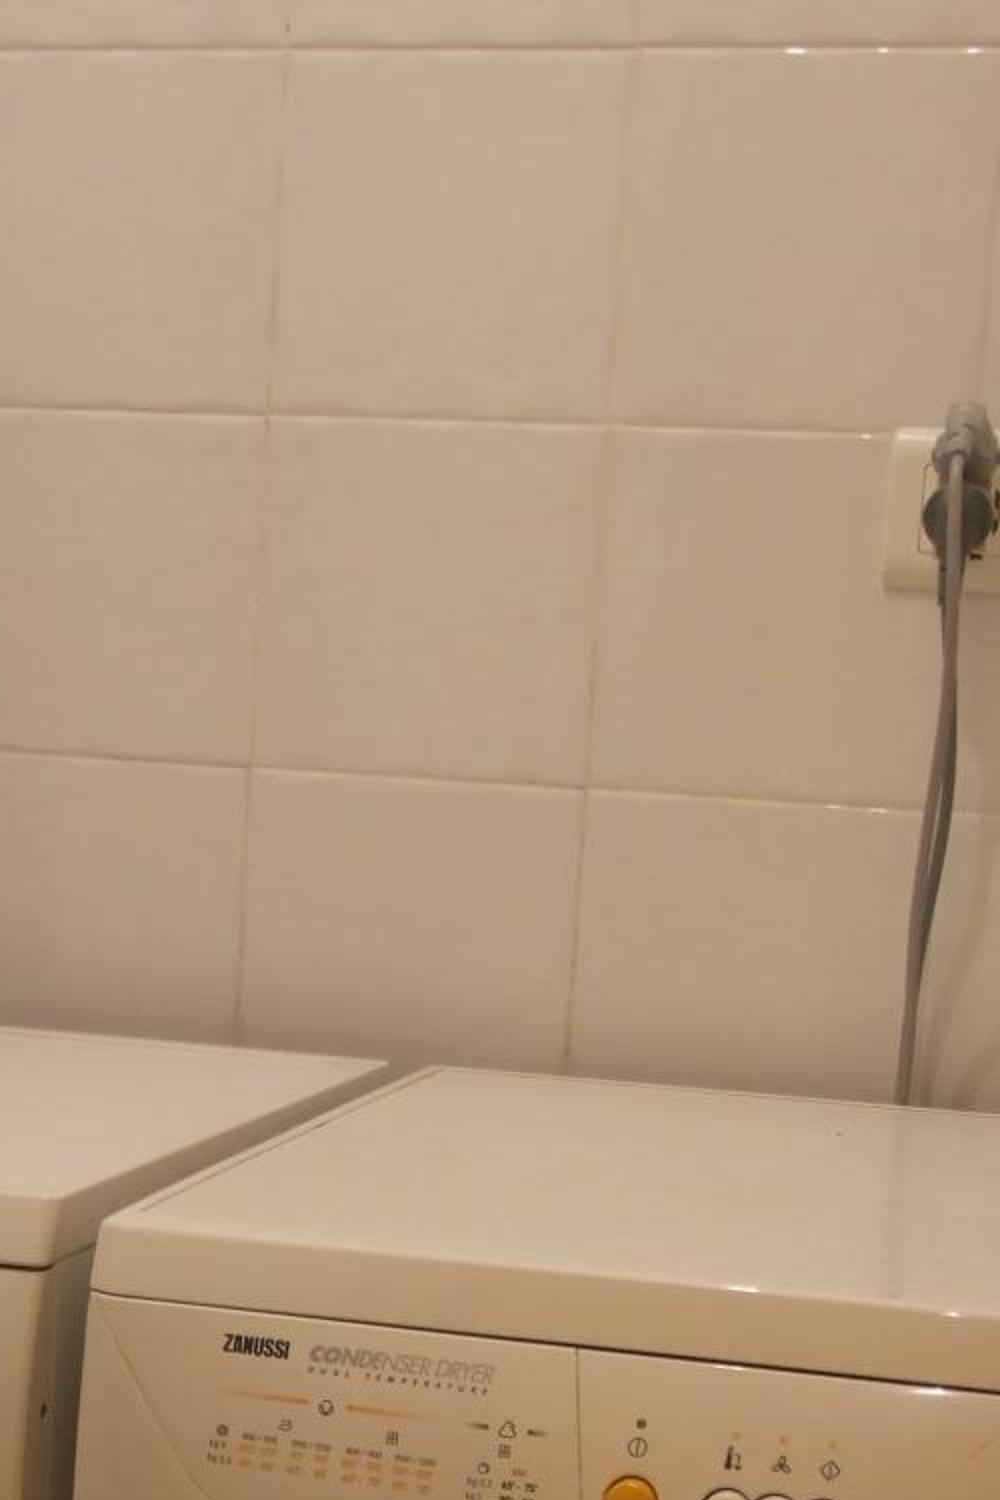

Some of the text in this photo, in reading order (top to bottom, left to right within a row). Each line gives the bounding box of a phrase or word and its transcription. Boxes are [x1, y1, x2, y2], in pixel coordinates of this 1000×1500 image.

[222, 1333, 496, 1385] ZANUSSI CONDENSER DRYER
